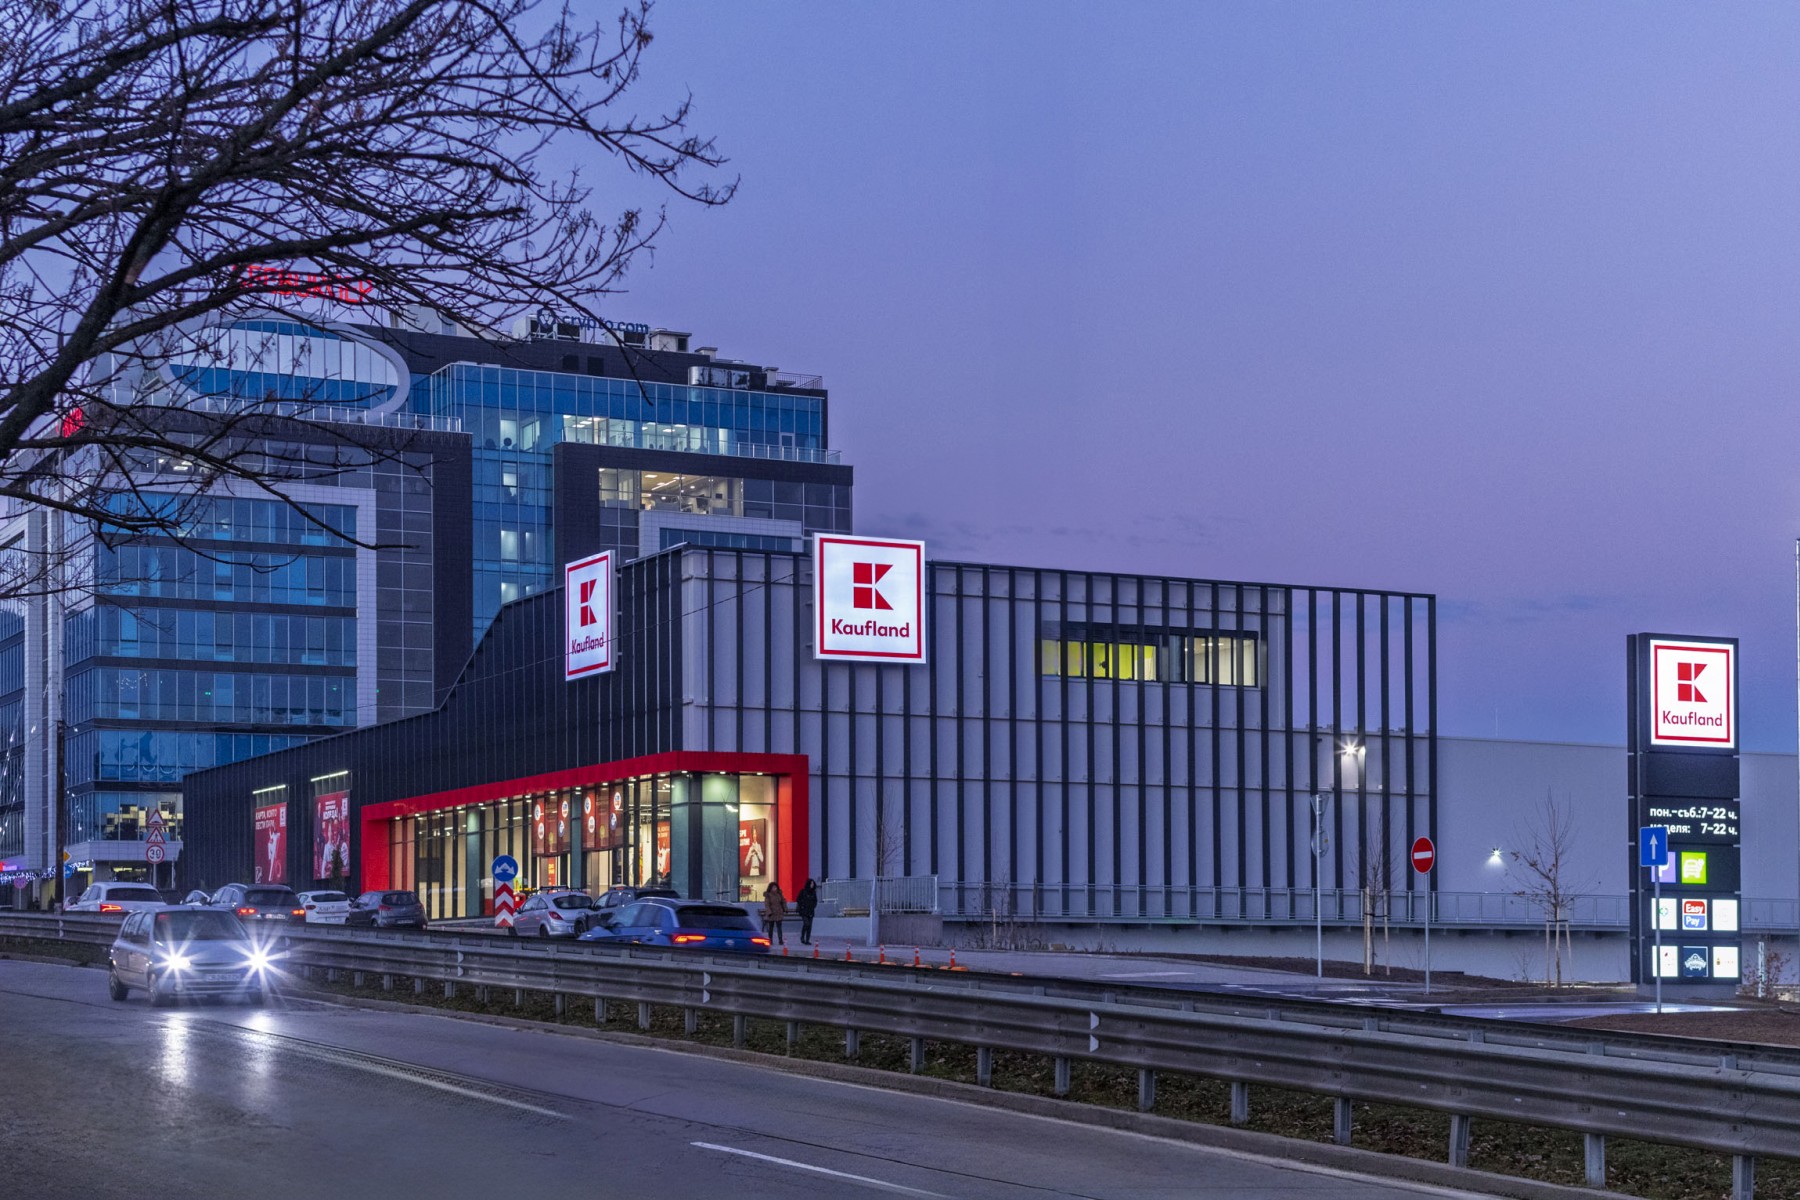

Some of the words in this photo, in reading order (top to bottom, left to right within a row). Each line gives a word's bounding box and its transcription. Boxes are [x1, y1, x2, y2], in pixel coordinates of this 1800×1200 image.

[831, 618, 910, 638] Kaufland
[571, 631, 605, 655] Kaufland
[1662, 710, 1723, 727] Kaufland
[1728, 811, 1738, 820] ч.
[1728, 826, 1738, 835] ч.
[1685, 903, 1704, 915] Easy
[1685, 916, 1700, 927] Pay
